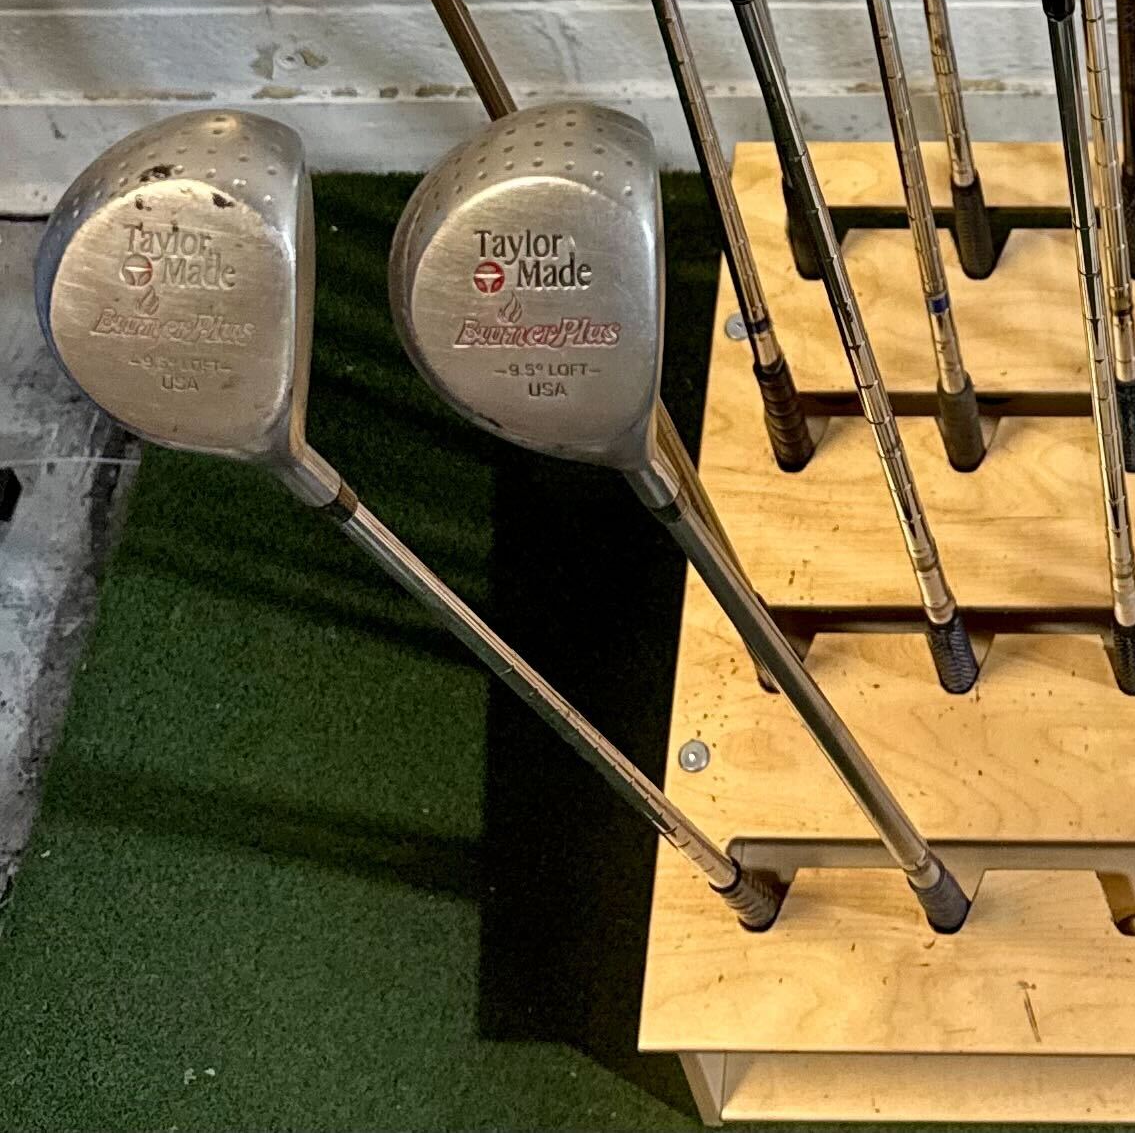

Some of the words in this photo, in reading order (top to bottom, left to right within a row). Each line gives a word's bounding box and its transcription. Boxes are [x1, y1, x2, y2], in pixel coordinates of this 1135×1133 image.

[122, 222, 213, 260] Taylor
[473, 229, 563, 265] Taylor
[161, 252, 237, 290] Made
[516, 252, 592, 290] Made
[161, 375, 199, 392] USA
[528, 382, 567, 397] USA
